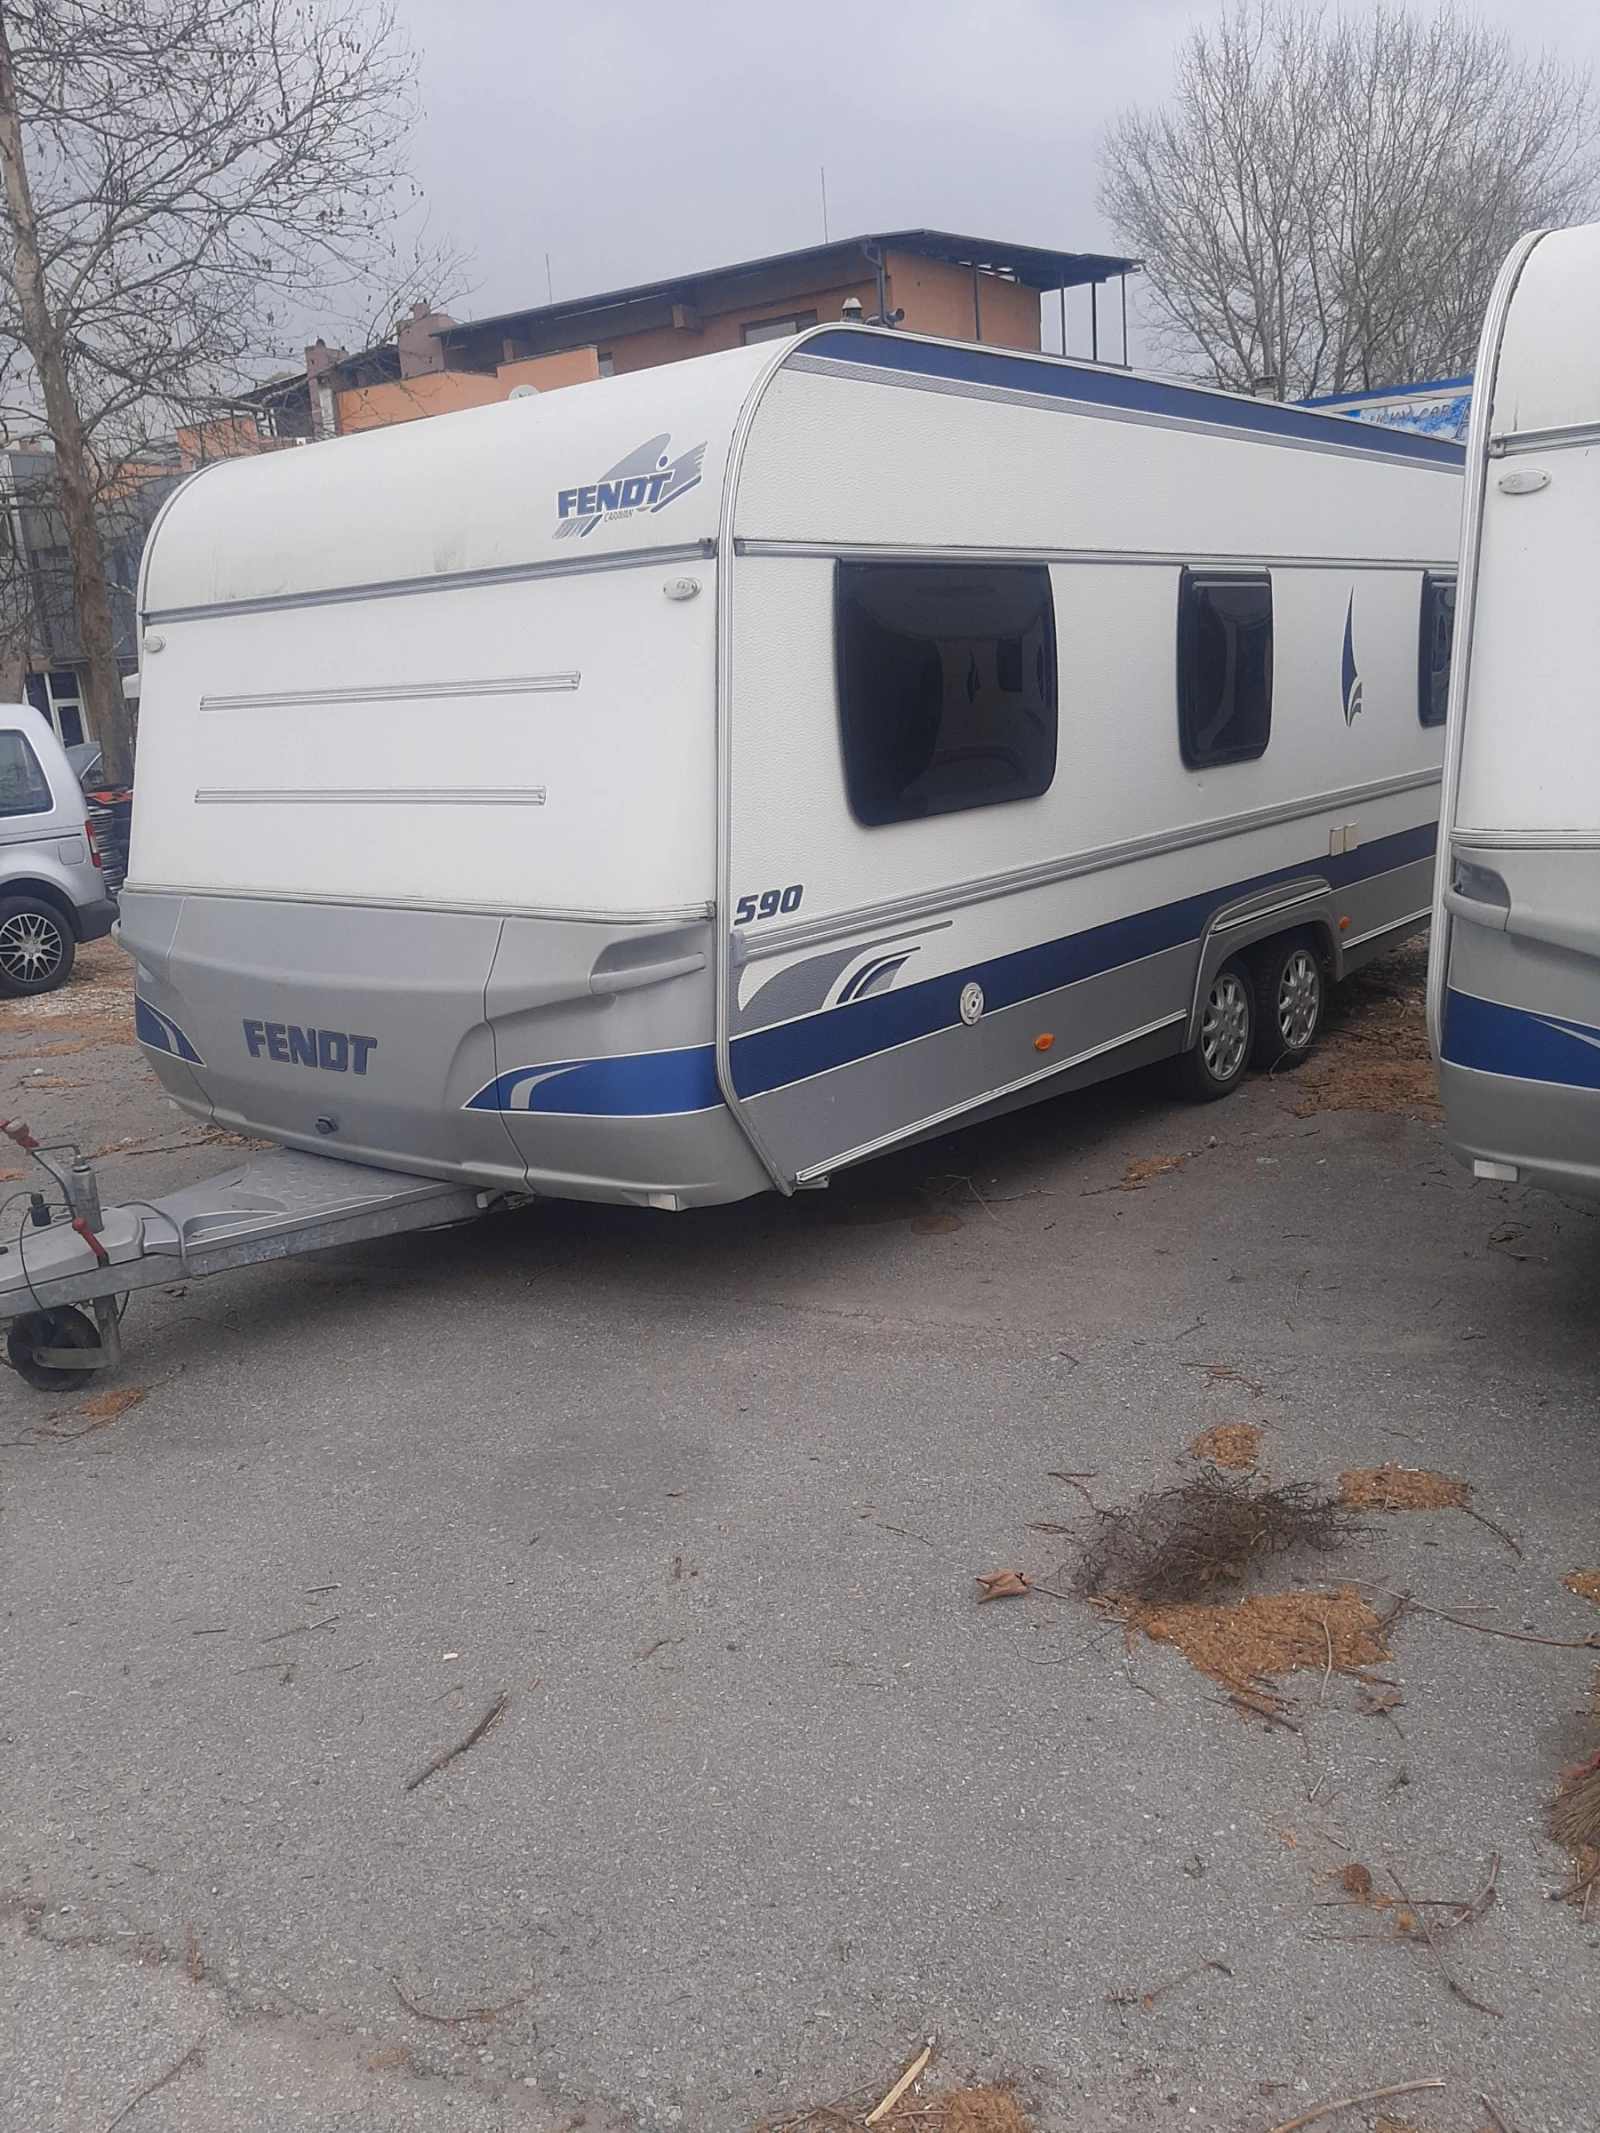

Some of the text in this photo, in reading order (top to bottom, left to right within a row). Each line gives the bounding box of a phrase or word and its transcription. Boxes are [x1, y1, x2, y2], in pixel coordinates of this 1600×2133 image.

[1361, 404, 1451, 426] UCKY CAR
[558, 472, 673, 519] FENDT
[734, 884, 803, 926] 590
[243, 1018, 377, 1075] FENDT
